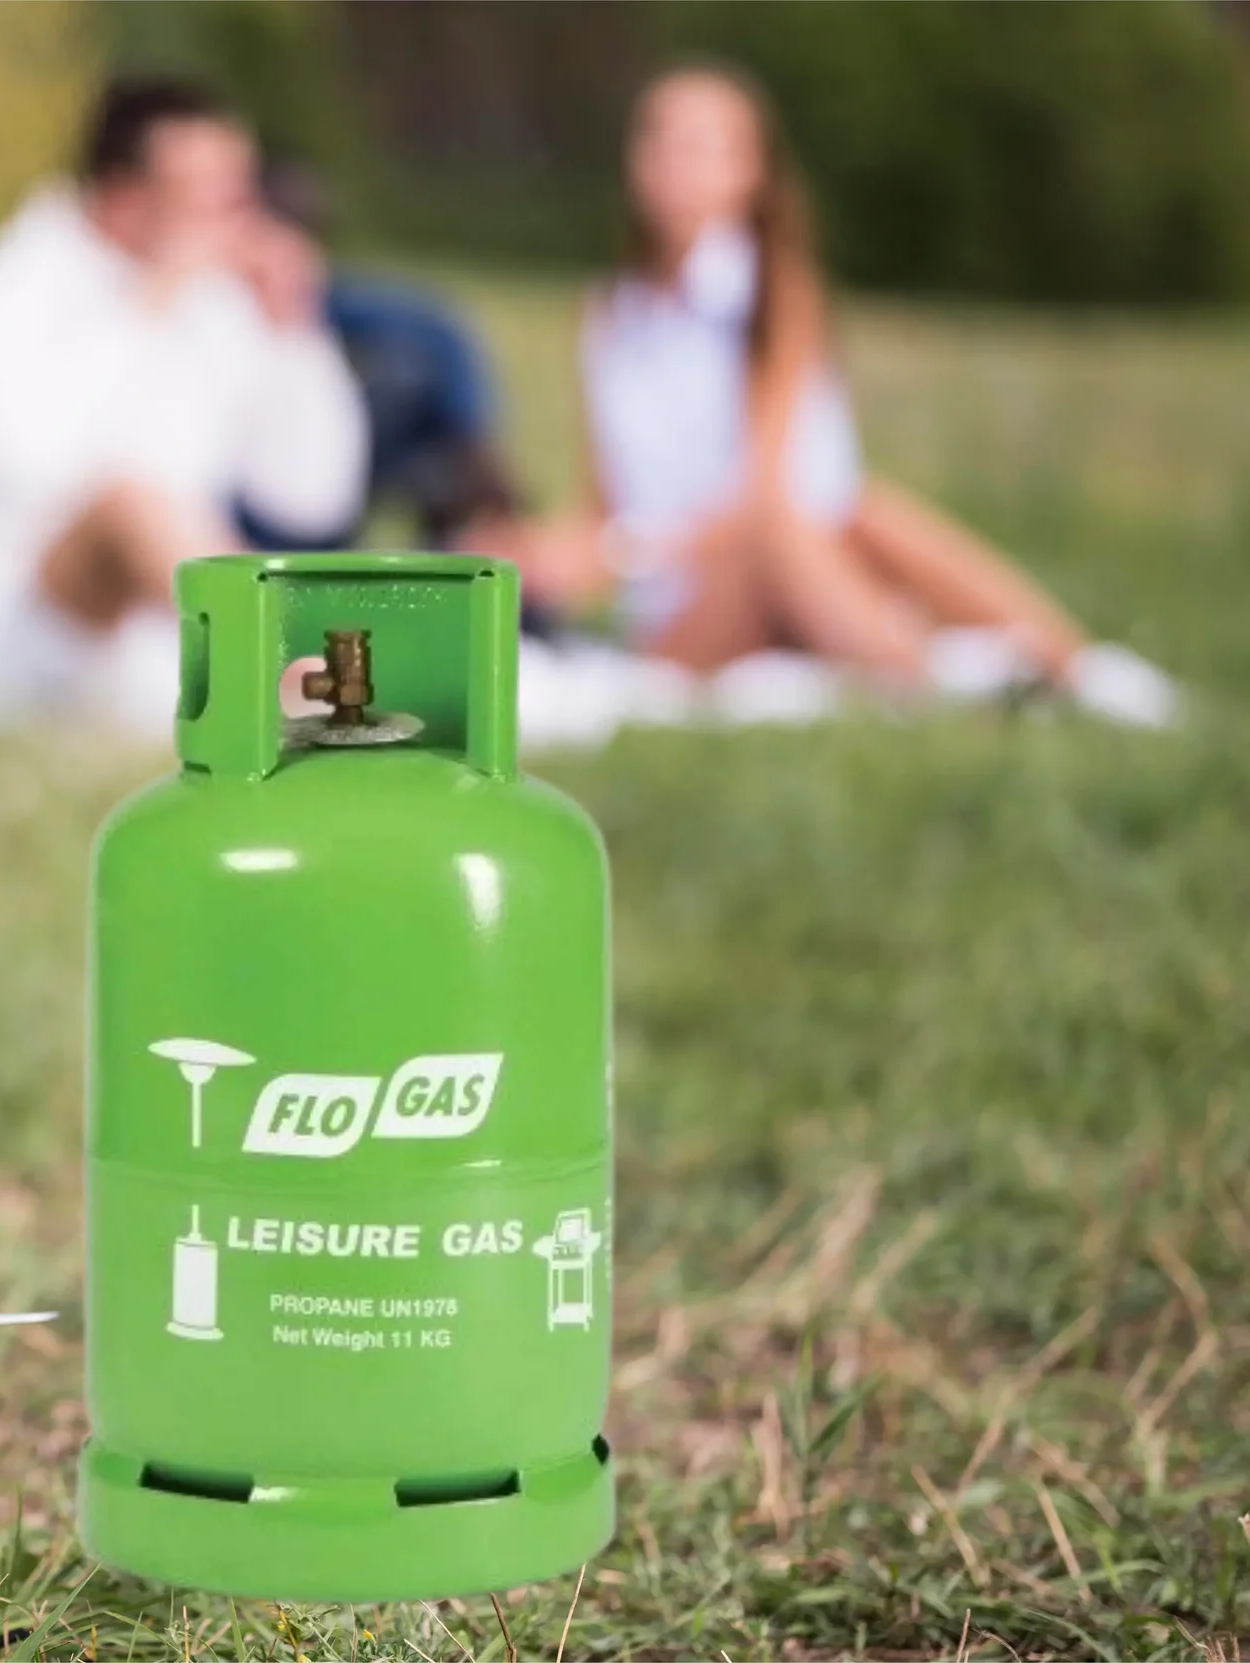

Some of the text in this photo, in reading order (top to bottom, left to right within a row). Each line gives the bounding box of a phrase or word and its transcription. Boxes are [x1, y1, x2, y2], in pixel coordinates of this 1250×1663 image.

[267, 1073, 485, 1137] FLO GAS
[227, 1216, 523, 1258] LEISURE GAS
[270, 1294, 375, 1318] PROPANE
[273, 1326, 452, 1351] Net Weight 11 KG
